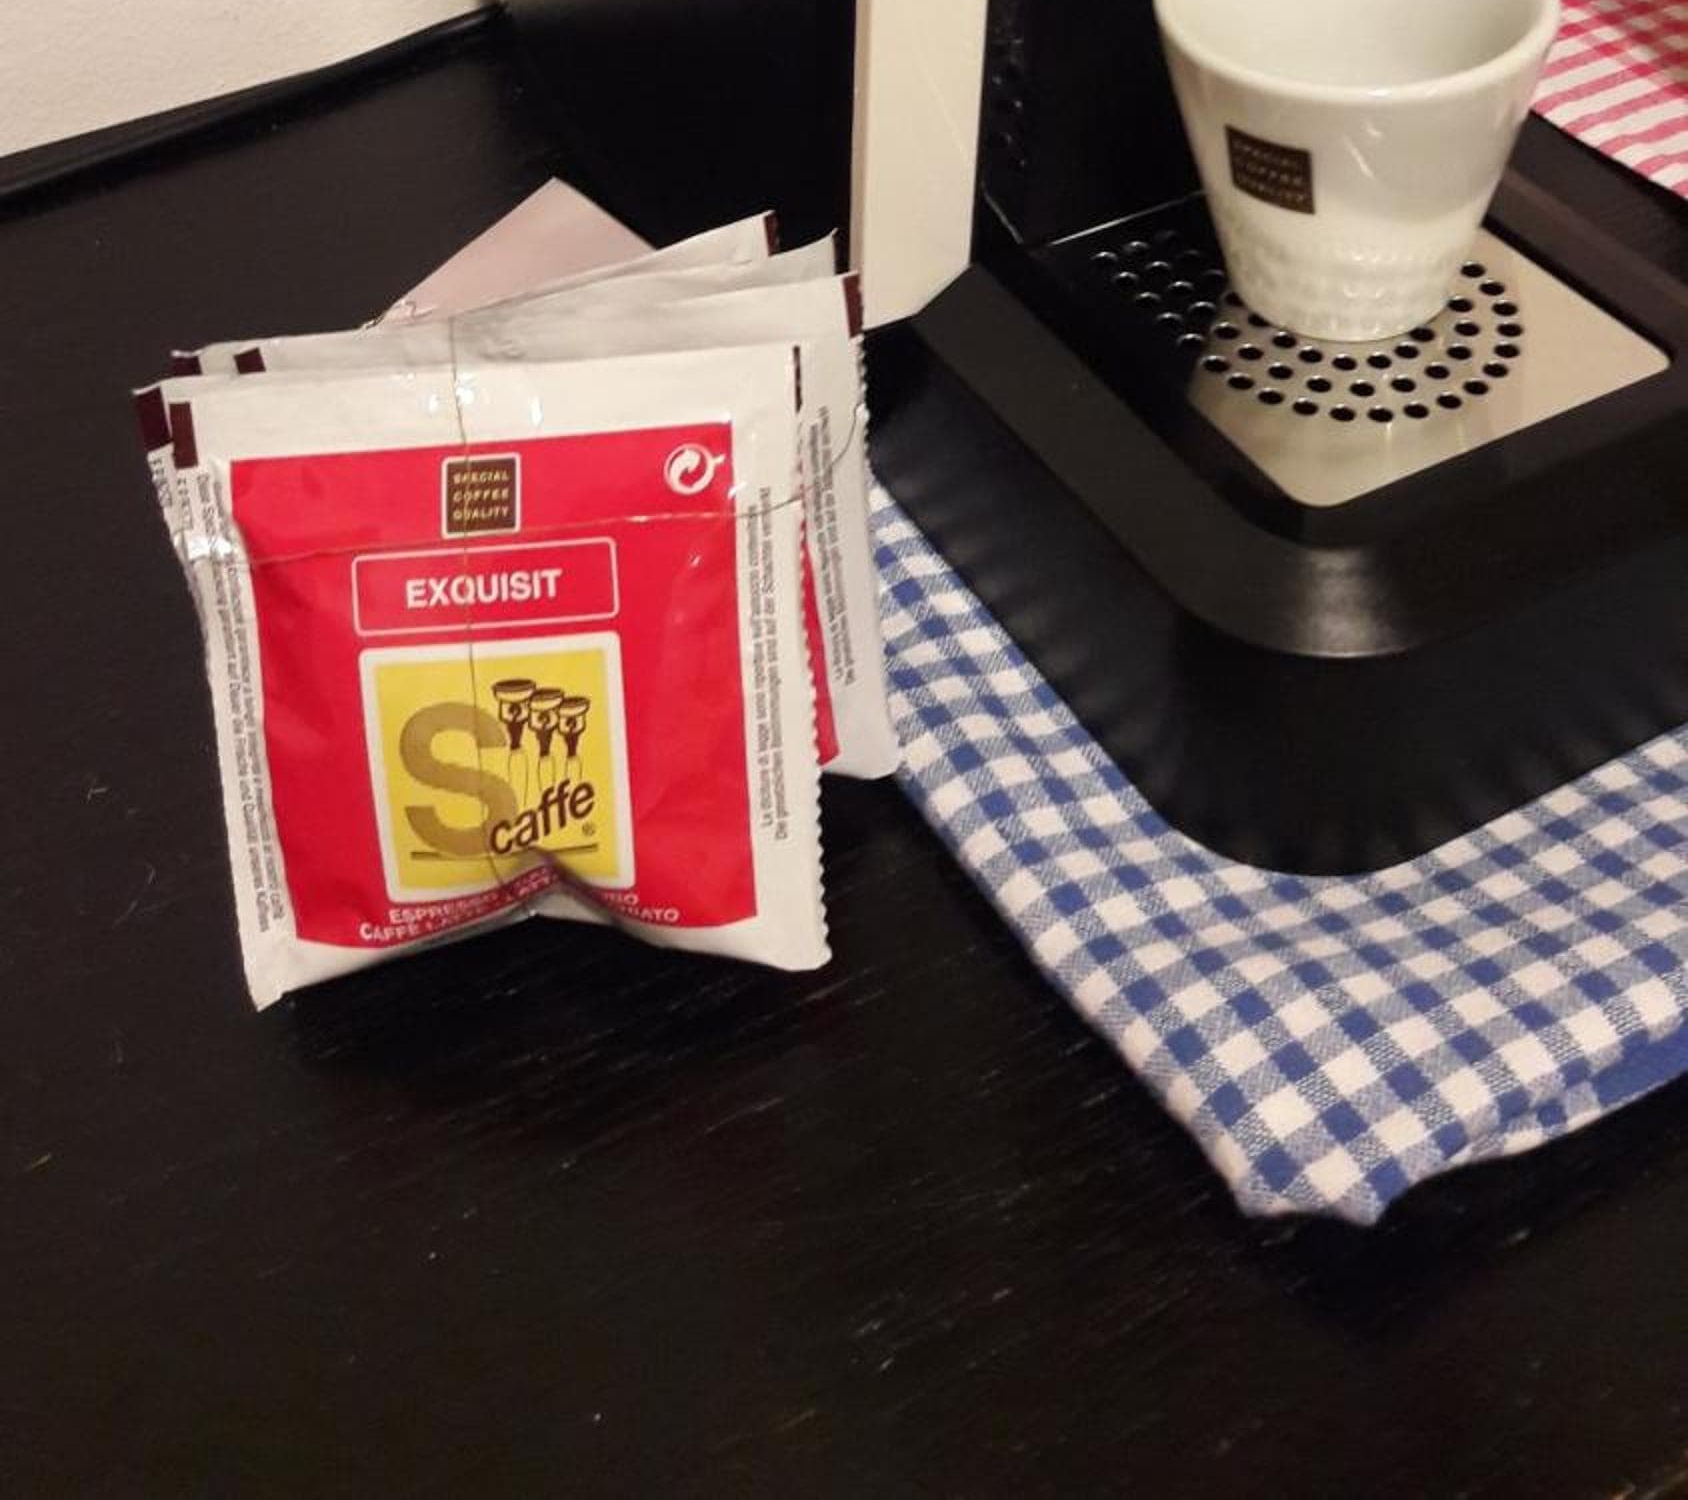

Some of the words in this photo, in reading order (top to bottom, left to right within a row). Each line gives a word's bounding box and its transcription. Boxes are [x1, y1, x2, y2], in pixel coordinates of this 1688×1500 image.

[453, 469, 510, 484] SPECIAL
[452, 487, 510, 502] COFFEE
[452, 506, 509, 521] QUALITY
[405, 568, 564, 610] EXQUISIT
[400, 702, 517, 856] S
[489, 778, 596, 855] caffe
